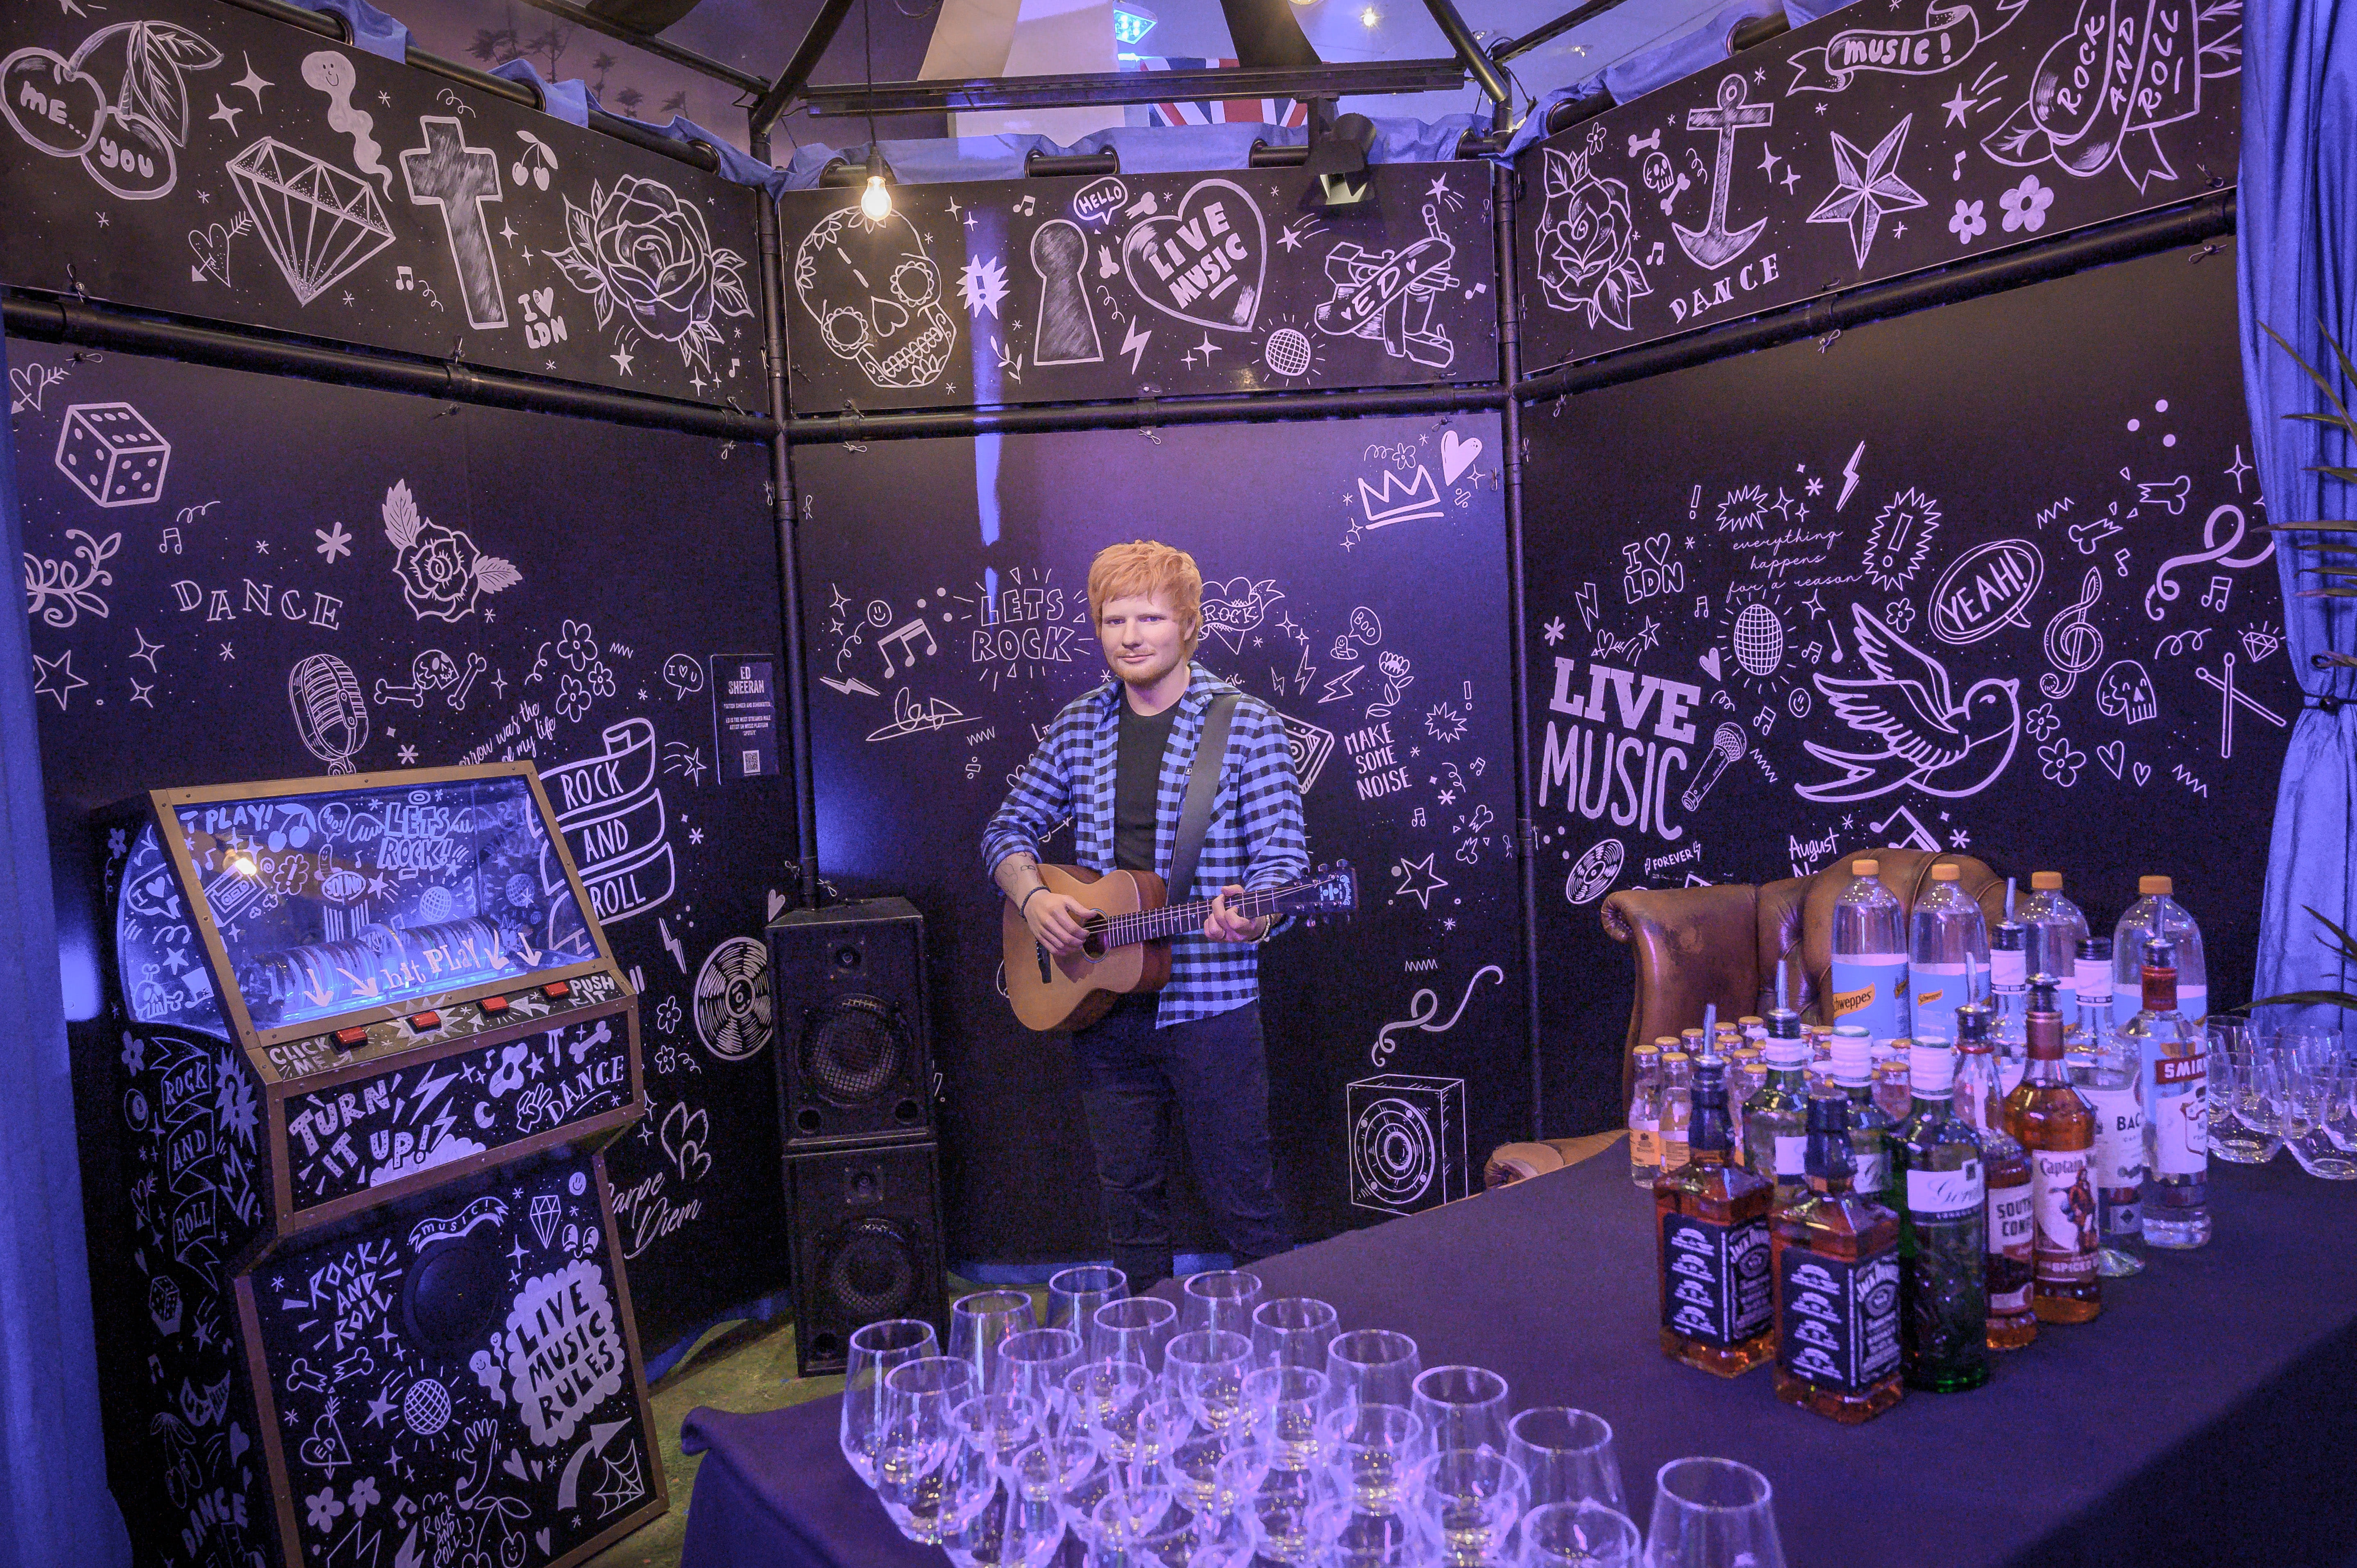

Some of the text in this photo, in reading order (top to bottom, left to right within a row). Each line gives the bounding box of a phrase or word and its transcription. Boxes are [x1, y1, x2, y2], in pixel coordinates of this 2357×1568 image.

[2057, 15, 2105, 115] ROCK
[2109, 16, 2135, 114] AND
[2138, 8, 2179, 118] ROLL
[1078, 185, 1123, 214] HELLO
[1149, 201, 1230, 282] LIVE
[1169, 232, 1248, 310] MUSIC
[1351, 267, 1400, 316] ED
[1669, 254, 1779, 324] DANCE
[525, 316, 567, 349] LDN
[1733, 528, 1843, 555] everything
[1624, 562, 1683, 604] LDN
[1750, 555, 1826, 578] happens
[171, 579, 343, 630] DANCE
[981, 589, 1064, 626] LETS
[1726, 581, 1763, 603] for
[1794, 575, 1862, 587] reason
[1939, 550, 2028, 631] YEAH!
[1204, 603, 1259, 624] ROCK
[1353, 610, 1376, 638] BOO
[973, 627, 1075, 662] ROCK
[728, 680, 764, 694] SHEERAN
[740, 666, 751, 680] ED
[1549, 655, 1701, 744] LIVE
[495, 716, 520, 744] was
[519, 700, 539, 722] the
[517, 736, 536, 758] my
[535, 716, 556, 740] life
[1344, 721, 1395, 755] MAKE
[1355, 745, 1397, 774] SOME
[1539, 721, 1688, 840] MUSIC
[560, 761, 624, 809] ROCK
[1356, 766, 1412, 800] NOISE
[206, 804, 273, 834] PLAY!
[377, 838, 454, 870] ROCK!
[583, 823, 629, 862] AND
[1653, 849, 1694, 870] FOREVER
[1789, 827, 1840, 862] August
[592, 874, 646, 920] ROLL
[381, 962, 426, 990] hit
[569, 976, 615, 996] PUSH
[269, 1036, 331, 1066] CLICK
[294, 1053, 327, 1077] ME
[164, 1062, 207, 1106] ROCK
[545, 1055, 624, 1126] DANCE
[288, 1079, 390, 1157] TURN
[173, 1129, 206, 1171] AND
[322, 1124, 431, 1178] IT UP!
[175, 1201, 211, 1242] ROLL
[624, 1197, 702, 1259] Diem
[310, 1241, 377, 1310] ROCK
[337, 1271, 376, 1315] AND
[335, 1290, 393, 1352] ROLL
[515, 1279, 591, 1361] LIVE
[529, 1310, 606, 1393] MUSIC
[539, 1340, 615, 1431] RULES
[315, 1438, 336, 1459] ED
[424, 1505, 455, 1541] ROCK
